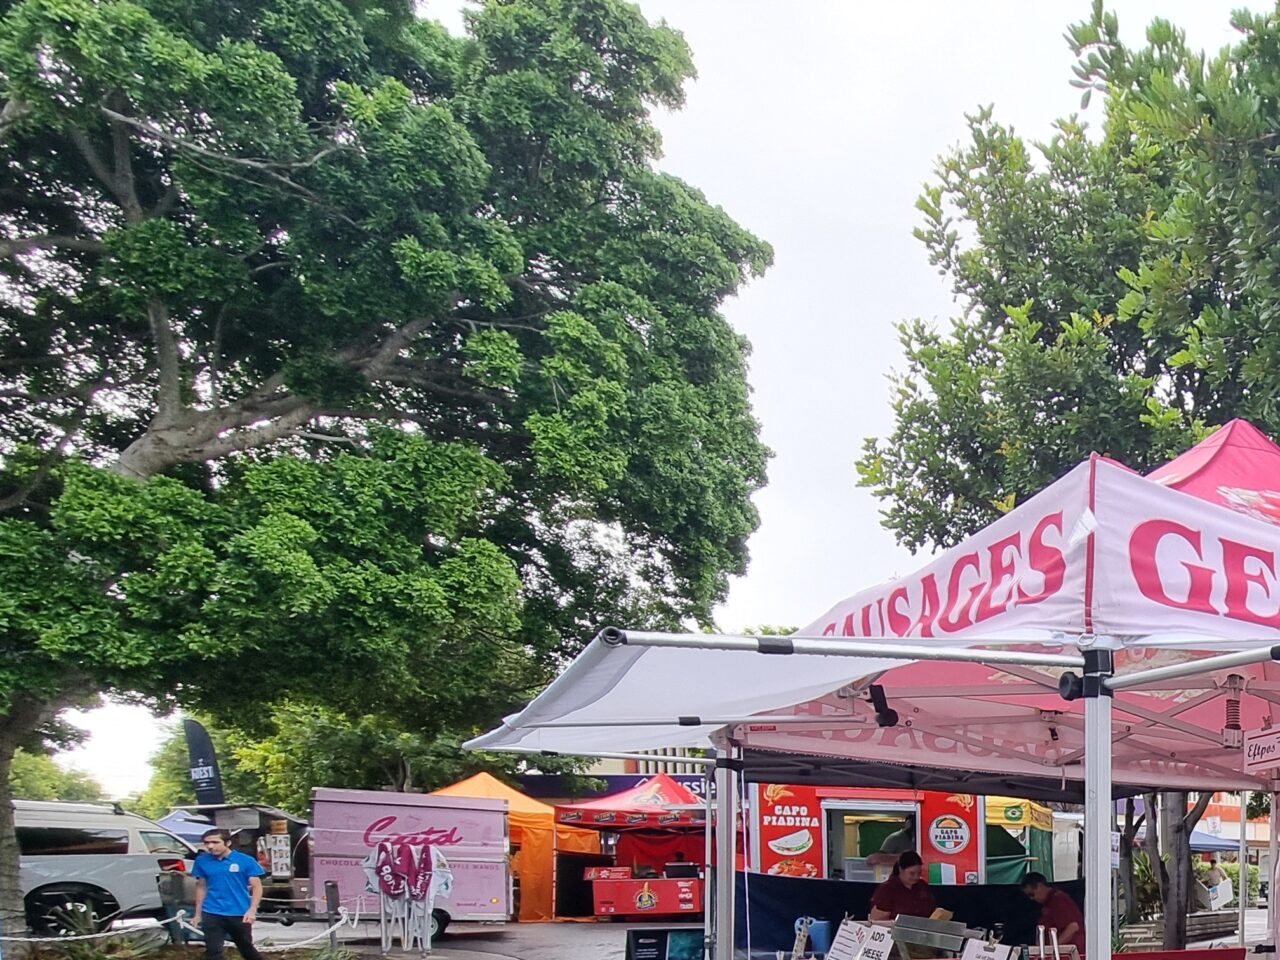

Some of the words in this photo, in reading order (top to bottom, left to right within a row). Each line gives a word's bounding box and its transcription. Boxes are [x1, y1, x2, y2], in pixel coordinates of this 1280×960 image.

[774, 805, 808, 816] CAPO
[763, 816, 820, 827] PIADINA
[869, 930, 886, 943] ADD
[861, 946, 885, 960] HEESE
